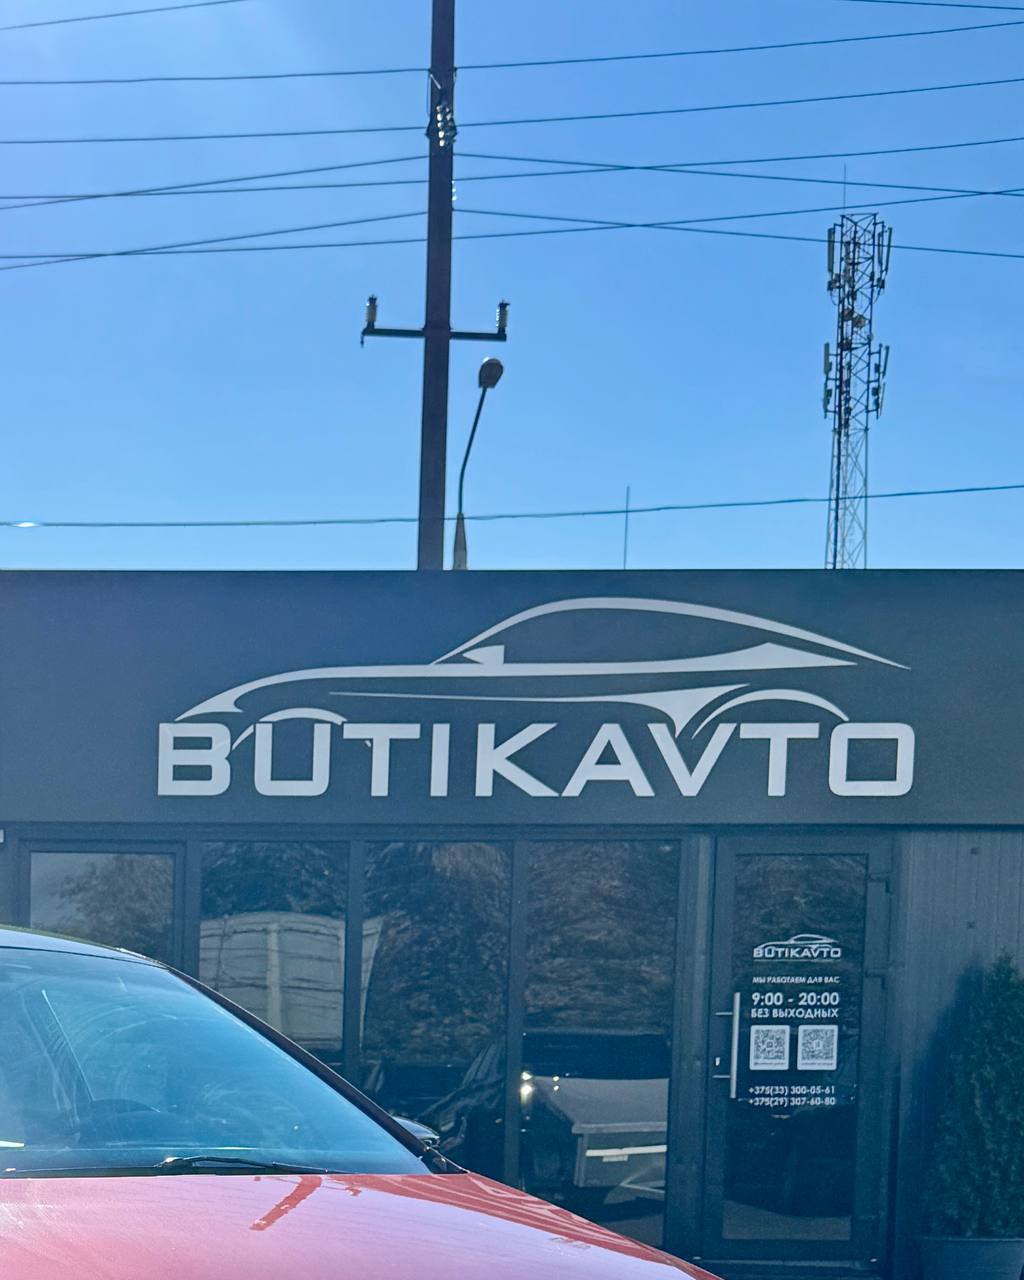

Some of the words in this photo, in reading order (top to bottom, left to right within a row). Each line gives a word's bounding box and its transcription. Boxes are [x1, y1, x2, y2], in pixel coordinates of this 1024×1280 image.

[157, 722, 916, 798] BUTIKAVTO
[753, 947, 842, 959] BUTIKAVTO
[752, 976, 766, 984] МЫ
[767, 976, 806, 984] РАБОТАЕМ
[807, 976, 823, 985] ДЛЯ
[824, 976, 840, 984] ВАС
[751, 991, 784, 1006] 9:00
[798, 991, 840, 1006] 20:00
[751, 1007, 770, 1018] БЕЗ
[772, 1007, 839, 1019] ВЫХОДНЫХ
[748, 1085, 789, 1096] +375(33)
[790, 1085, 835, 1095] 300-05-61
